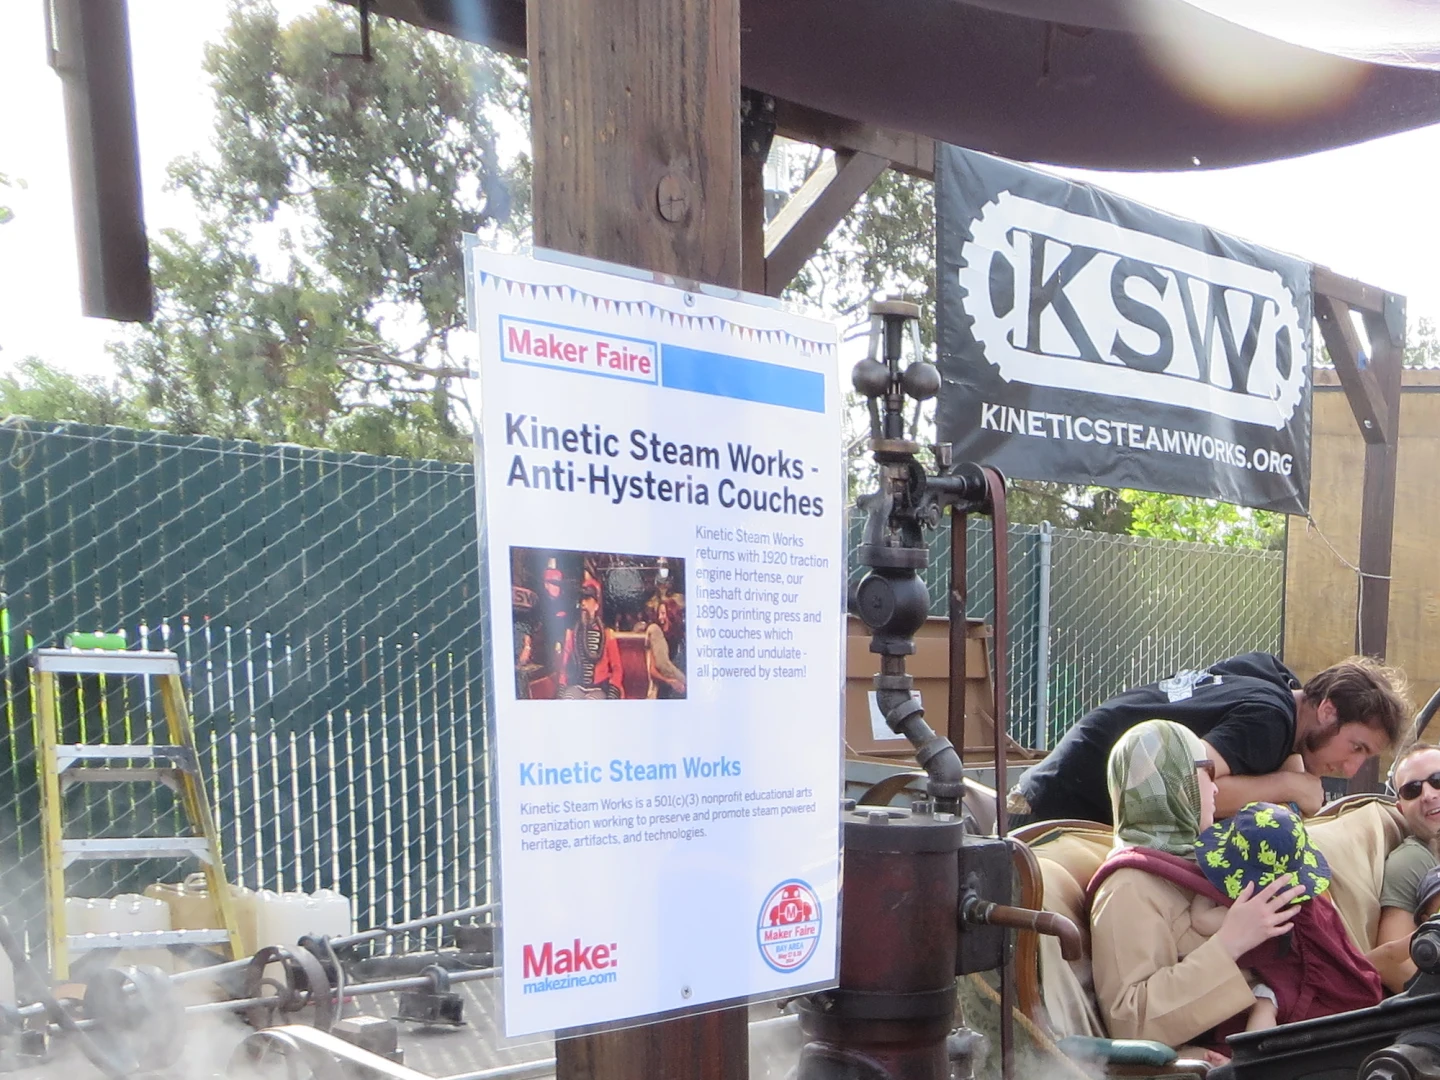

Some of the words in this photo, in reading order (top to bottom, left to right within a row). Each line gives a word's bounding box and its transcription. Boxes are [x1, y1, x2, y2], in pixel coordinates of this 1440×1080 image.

[1006, 227, 1281, 400] KSW
[508, 326, 589, 364] Maker
[596, 342, 651, 374] Faire
[505, 412, 620, 458] Kinetic
[630, 429, 720, 470] Steam
[727, 442, 804, 481] Works
[981, 402, 1293, 476] KINETICSTEAMWORKS.ORG
[506, 454, 709, 505] Anti-Hysteria
[718, 478, 824, 517] Couches
[695, 525, 733, 542] Kinetic
[735, 528, 770, 545] Steam
[772, 532, 804, 548] Works
[696, 547, 735, 561] returns
[737, 550, 760, 564] with
[762, 551, 787, 565] 1920
[790, 554, 829, 568] traction
[696, 568, 732, 583] engine
[734, 568, 784, 585] Hortense,
[787, 574, 804, 585] our
[696, 585, 742, 601] lineshaft
[744, 588, 779, 606] driving
[781, 592, 799, 603] our
[696, 605, 728, 620] 1890s
[731, 607, 771, 624] printing
[773, 611, 801, 624] press
[803, 611, 822, 623] and
[696, 625, 716, 638] two
[718, 626, 762, 640] couches
[764, 627, 793, 641] which
[696, 645, 734, 658] vibrate
[736, 646, 755, 659] and
[757, 646, 801, 659] undulate
[696, 664, 709, 678] all
[712, 665, 756, 680] powered
[758, 665, 771, 680] by
[772, 666, 807, 678] steam!
[519, 761, 602, 786] Kinetic
[609, 759, 677, 782] Steam
[683, 755, 741, 779] Works
[520, 802, 560, 815] Kinetic
[563, 800, 598, 813] Steam
[600, 797, 633, 810] Works
[635, 797, 644, 808] is
[646, 799, 652, 807] a
[654, 793, 699, 809] 501(c)(3)
[701, 791, 742, 805] nonprofit
[744, 788, 794, 801] educational
[795, 787, 812, 798] arts
[521, 819, 590, 835] organization
[592, 816, 634, 828] working
[637, 815, 647, 825] to
[649, 812, 691, 827] preserve
[693, 810, 710, 821] and
[712, 807, 750, 822] promote
[752, 806, 779, 817] steam
[781, 802, 816, 817] powered
[521, 837, 571, 851] heritage,
[574, 833, 621, 848] artifacts,
[623, 831, 642, 844] and
[645, 826, 707, 841] technologies.
[764, 929, 793, 942] Maker
[795, 925, 816, 937] Faire
[523, 938, 618, 979] Make:
[523, 971, 617, 995] makezine.com
